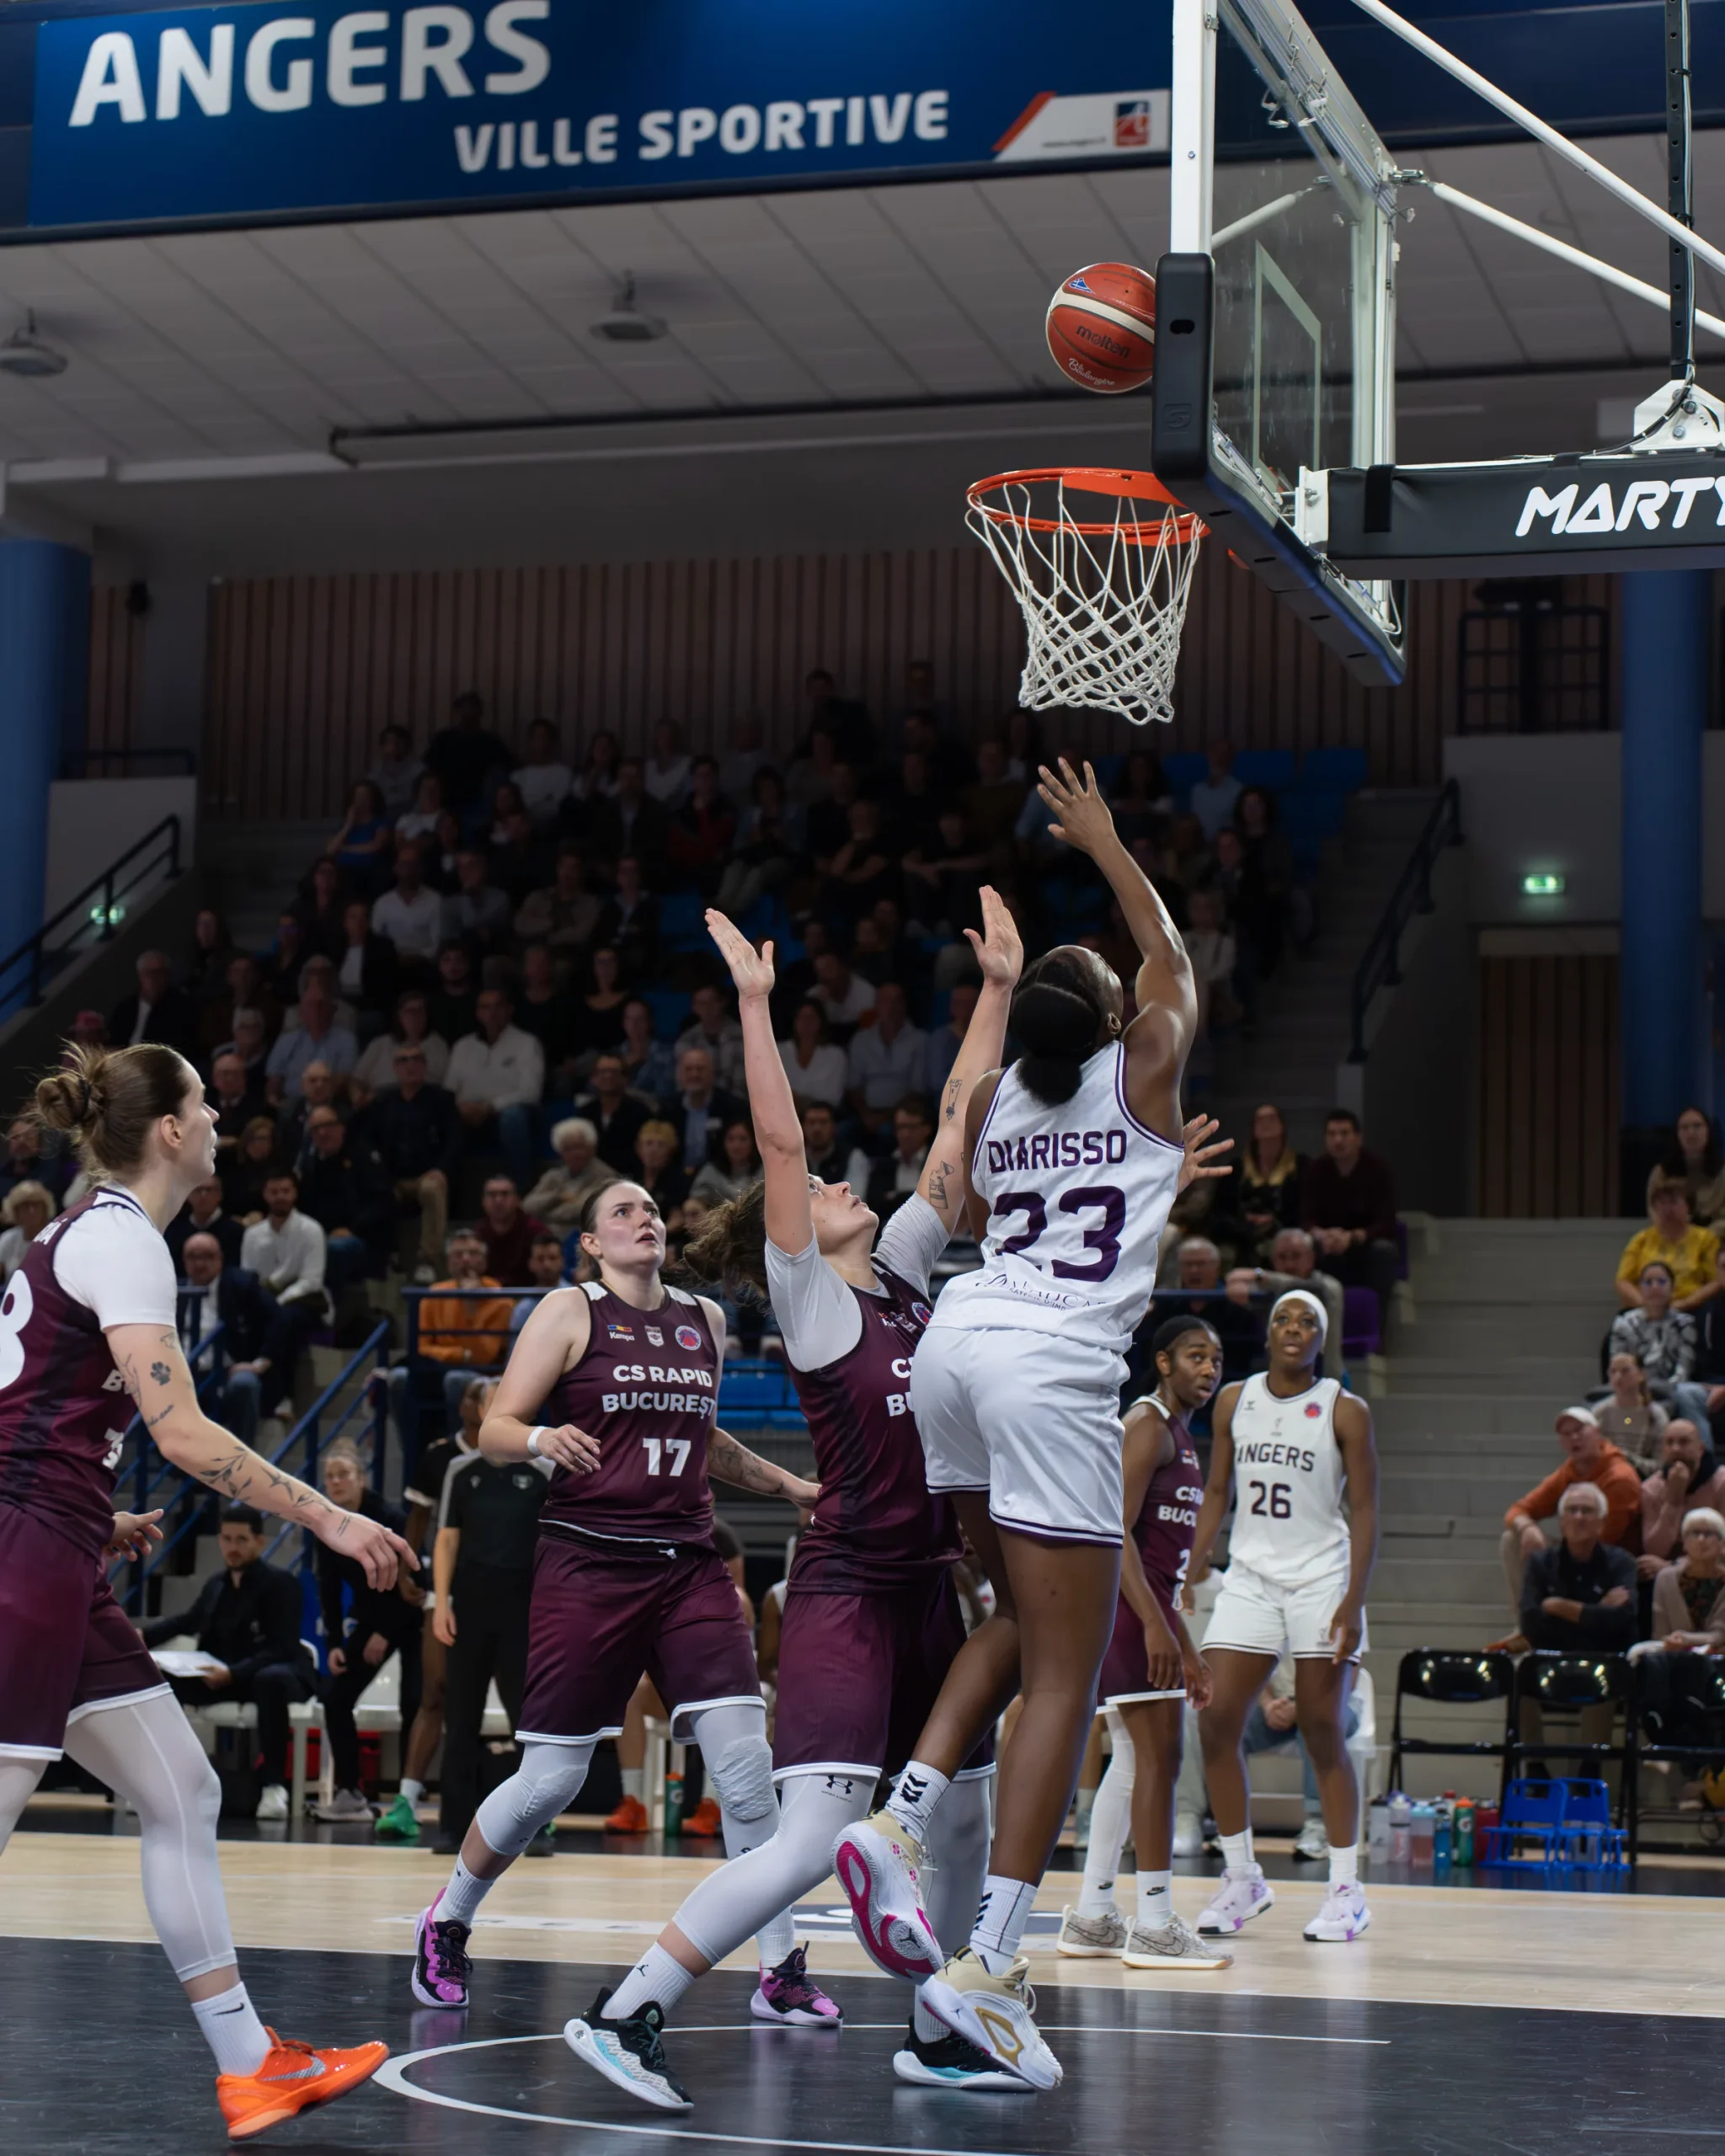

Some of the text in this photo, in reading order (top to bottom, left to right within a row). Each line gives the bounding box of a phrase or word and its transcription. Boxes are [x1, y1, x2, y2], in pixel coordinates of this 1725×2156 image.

[68, 0, 550, 126] ANGERS
[455, 90, 949, 173] VILLE SPORTIVE
[1076, 325, 1130, 359] molten
[986, 1129, 1127, 1174] DIARISSO
[992, 1185, 1126, 1283] 23
[609, 1331, 635, 1342] Kempa
[612, 1365, 713, 1388] CS RAPID
[643, 1438, 692, 1477] 17
[1249, 1480, 1292, 1519] 26
